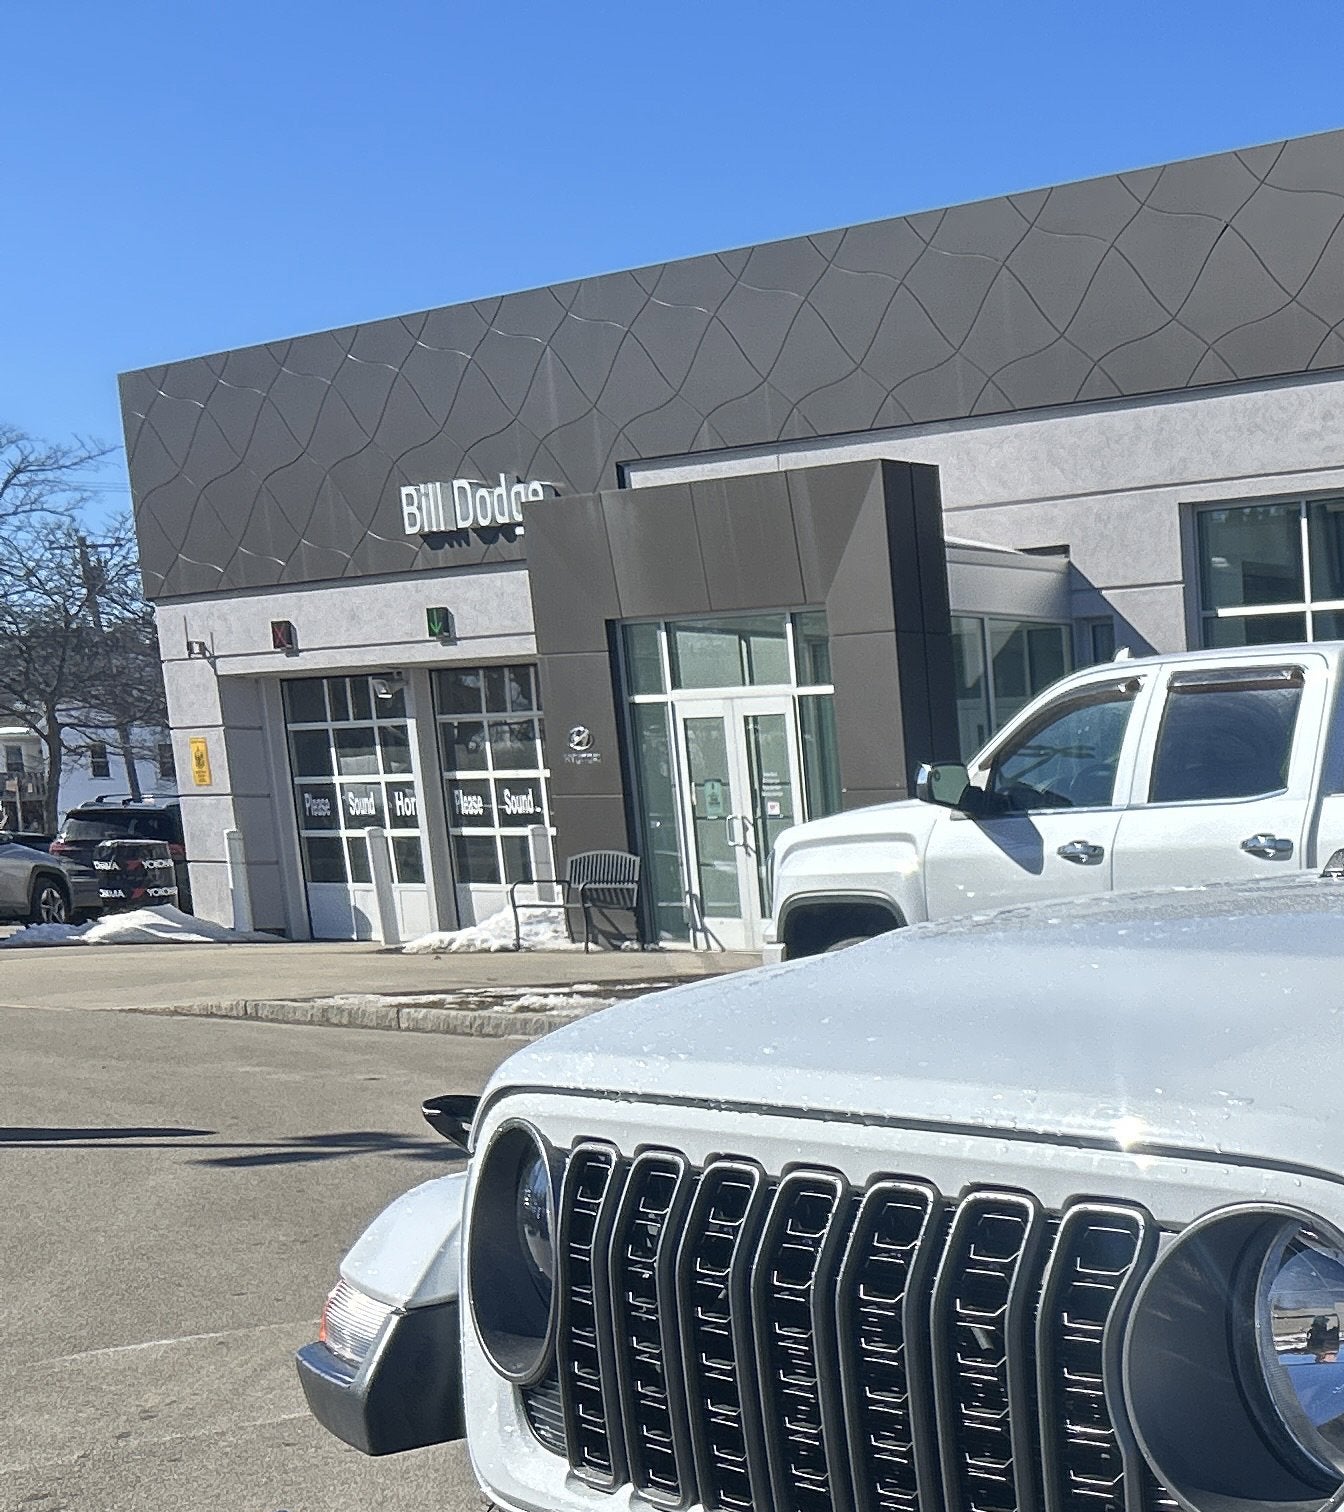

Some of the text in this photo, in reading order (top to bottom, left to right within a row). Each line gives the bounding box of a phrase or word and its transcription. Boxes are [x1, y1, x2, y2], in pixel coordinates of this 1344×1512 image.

[401, 481, 446, 535] Bill
[304, 791, 418, 817] Please Sound Hor
[454, 788, 535, 815] Please Sound
